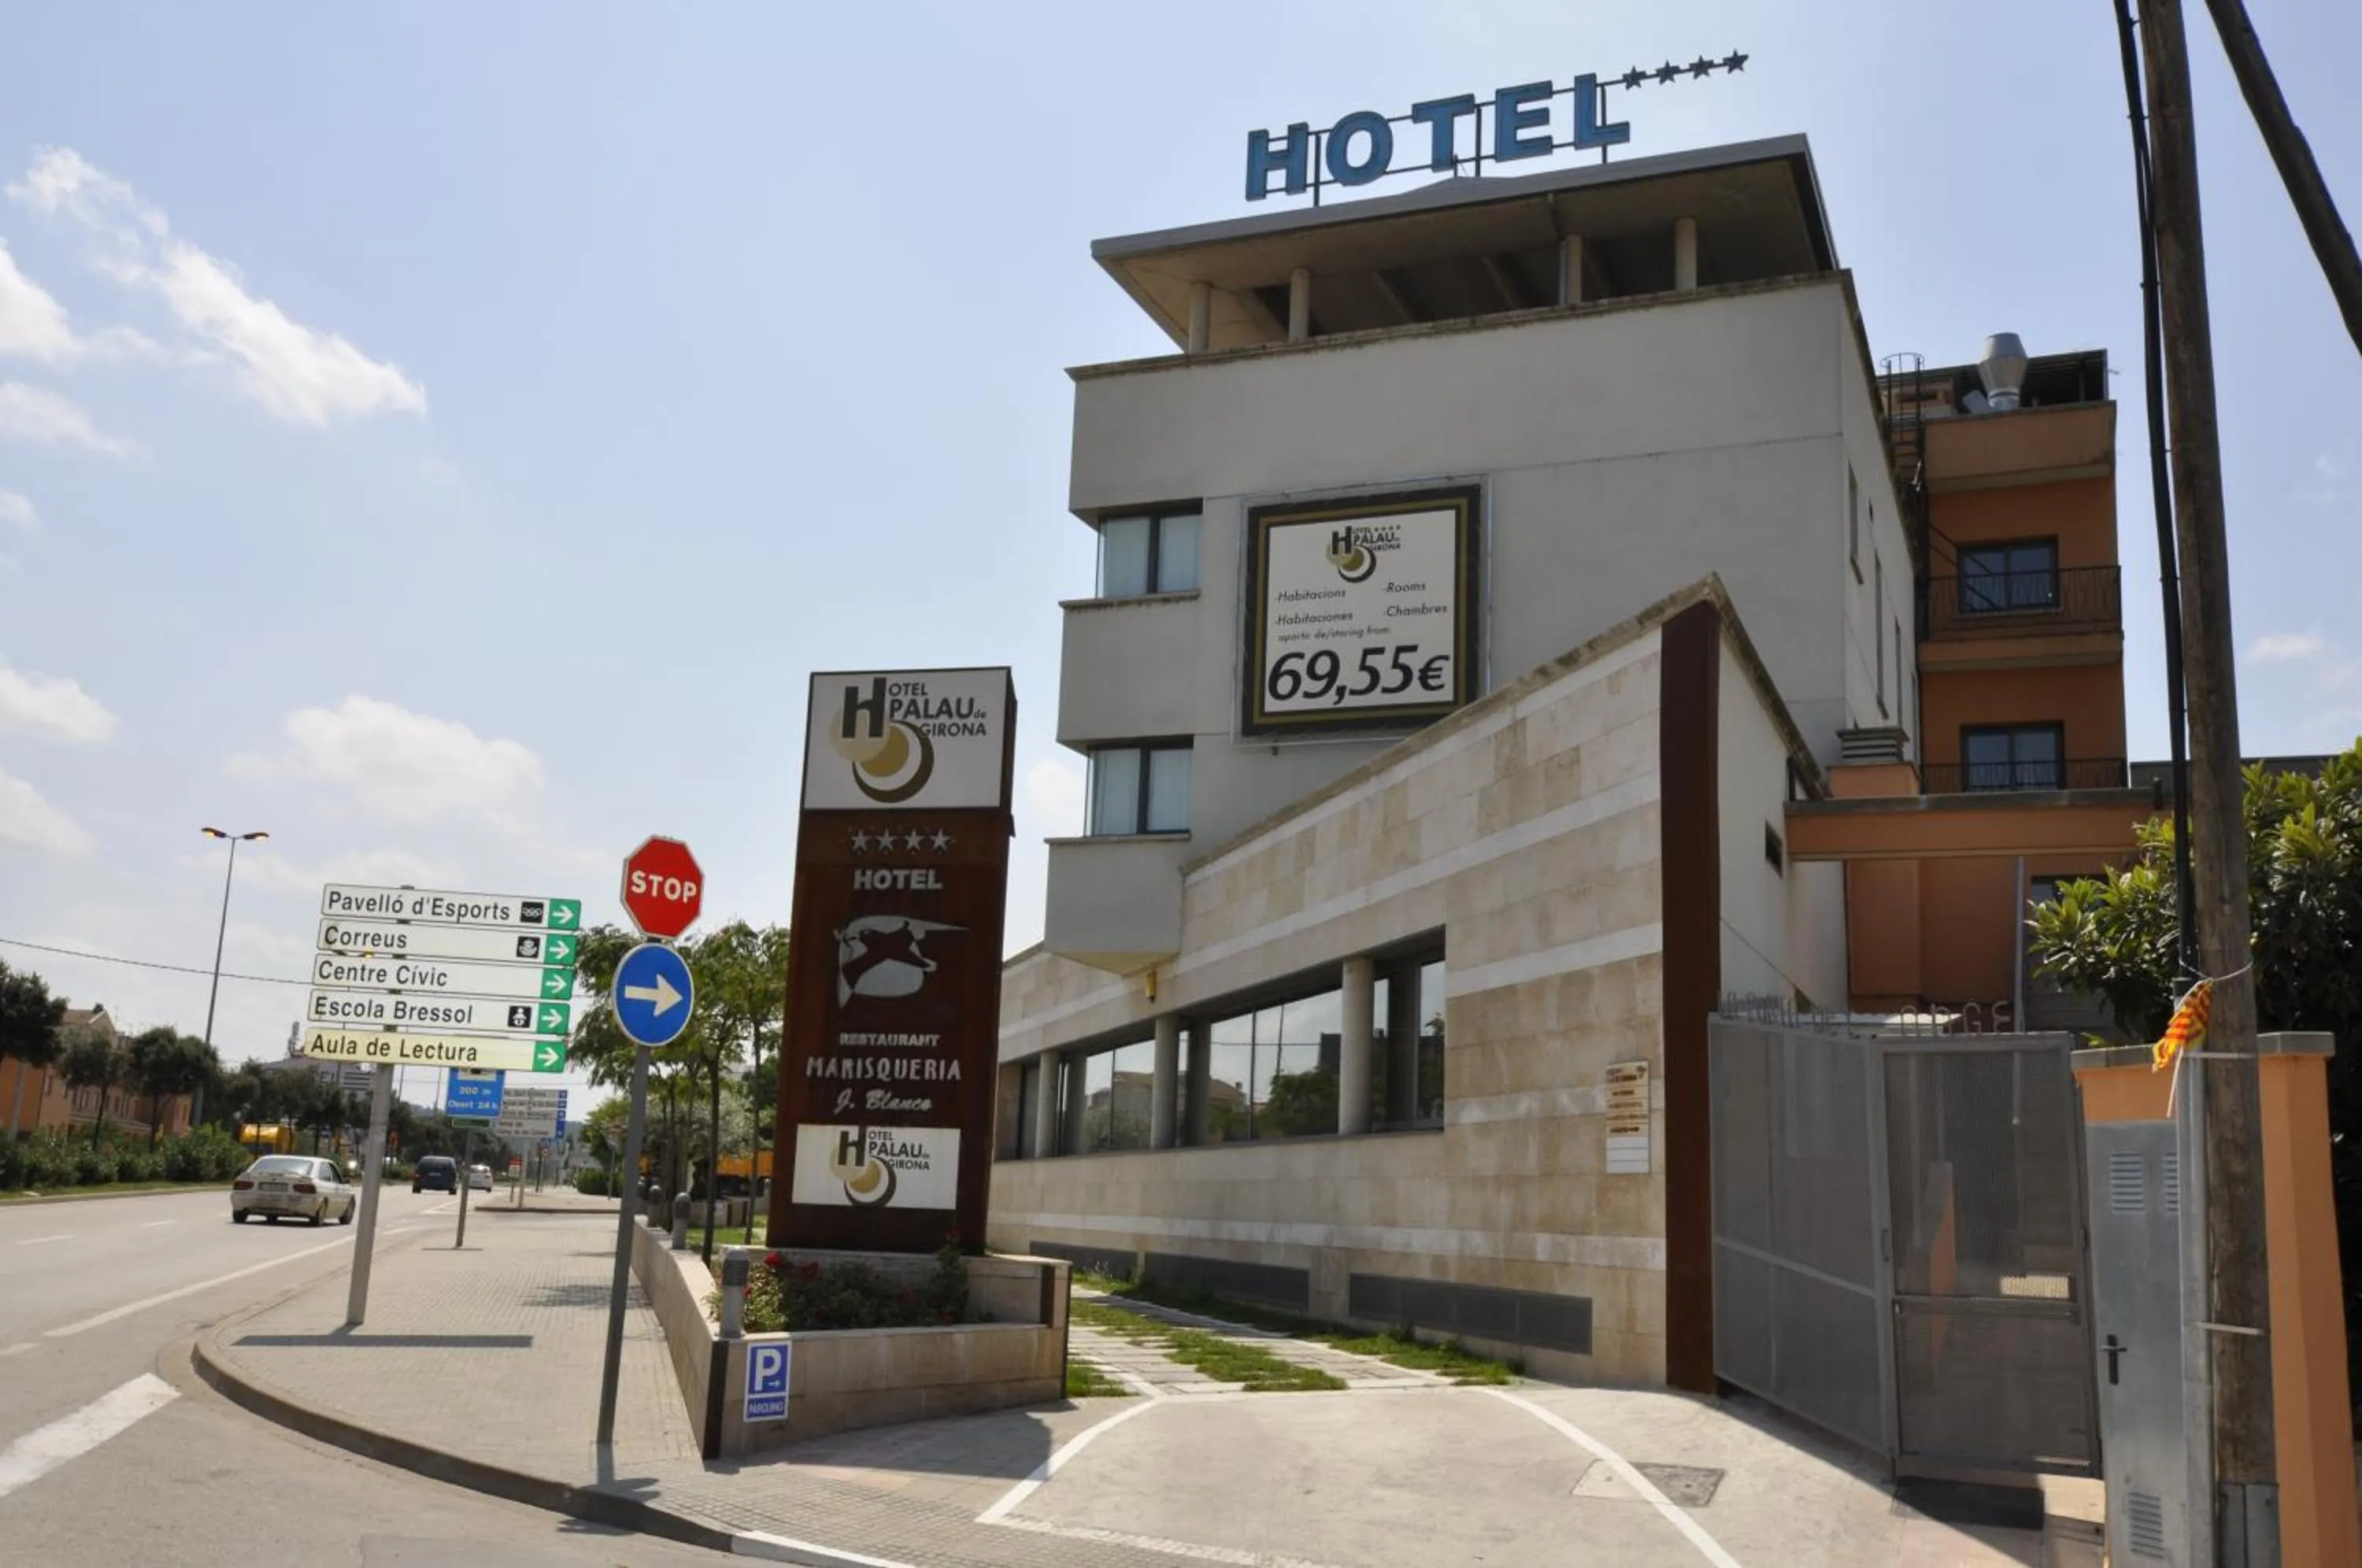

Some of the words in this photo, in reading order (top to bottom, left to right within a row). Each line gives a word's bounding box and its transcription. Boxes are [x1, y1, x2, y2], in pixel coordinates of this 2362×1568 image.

[1245, 72, 1630, 202] HOTEL
[1268, 644, 1450, 705] 69,55€
[889, 697, 975, 719] PALAU
[972, 710, 987, 719] de
[919, 723, 987, 737] GIRONA
[631, 870, 697, 903] STOP
[853, 869, 942, 889] HOTEL
[328, 891, 403, 914] Pavelló
[412, 896, 510, 923] d'Esports
[324, 926, 407, 949] Correus
[318, 960, 387, 983] Centre
[396, 964, 447, 986] Cívic
[314, 997, 383, 1018] Escola
[394, 1000, 472, 1023] Bressol
[311, 1034, 356, 1056] Aula
[366, 1037, 391, 1057] de
[399, 1038, 477, 1062] Lectura
[839, 1033, 941, 1046] RESTAURANT
[806, 1056, 961, 1081] MARISQUERIA
[865, 1089, 932, 1111] Blanco
[868, 1141, 922, 1158] PALAU
[886, 1159, 930, 1170] GIRONA
[754, 1348, 782, 1392] P
